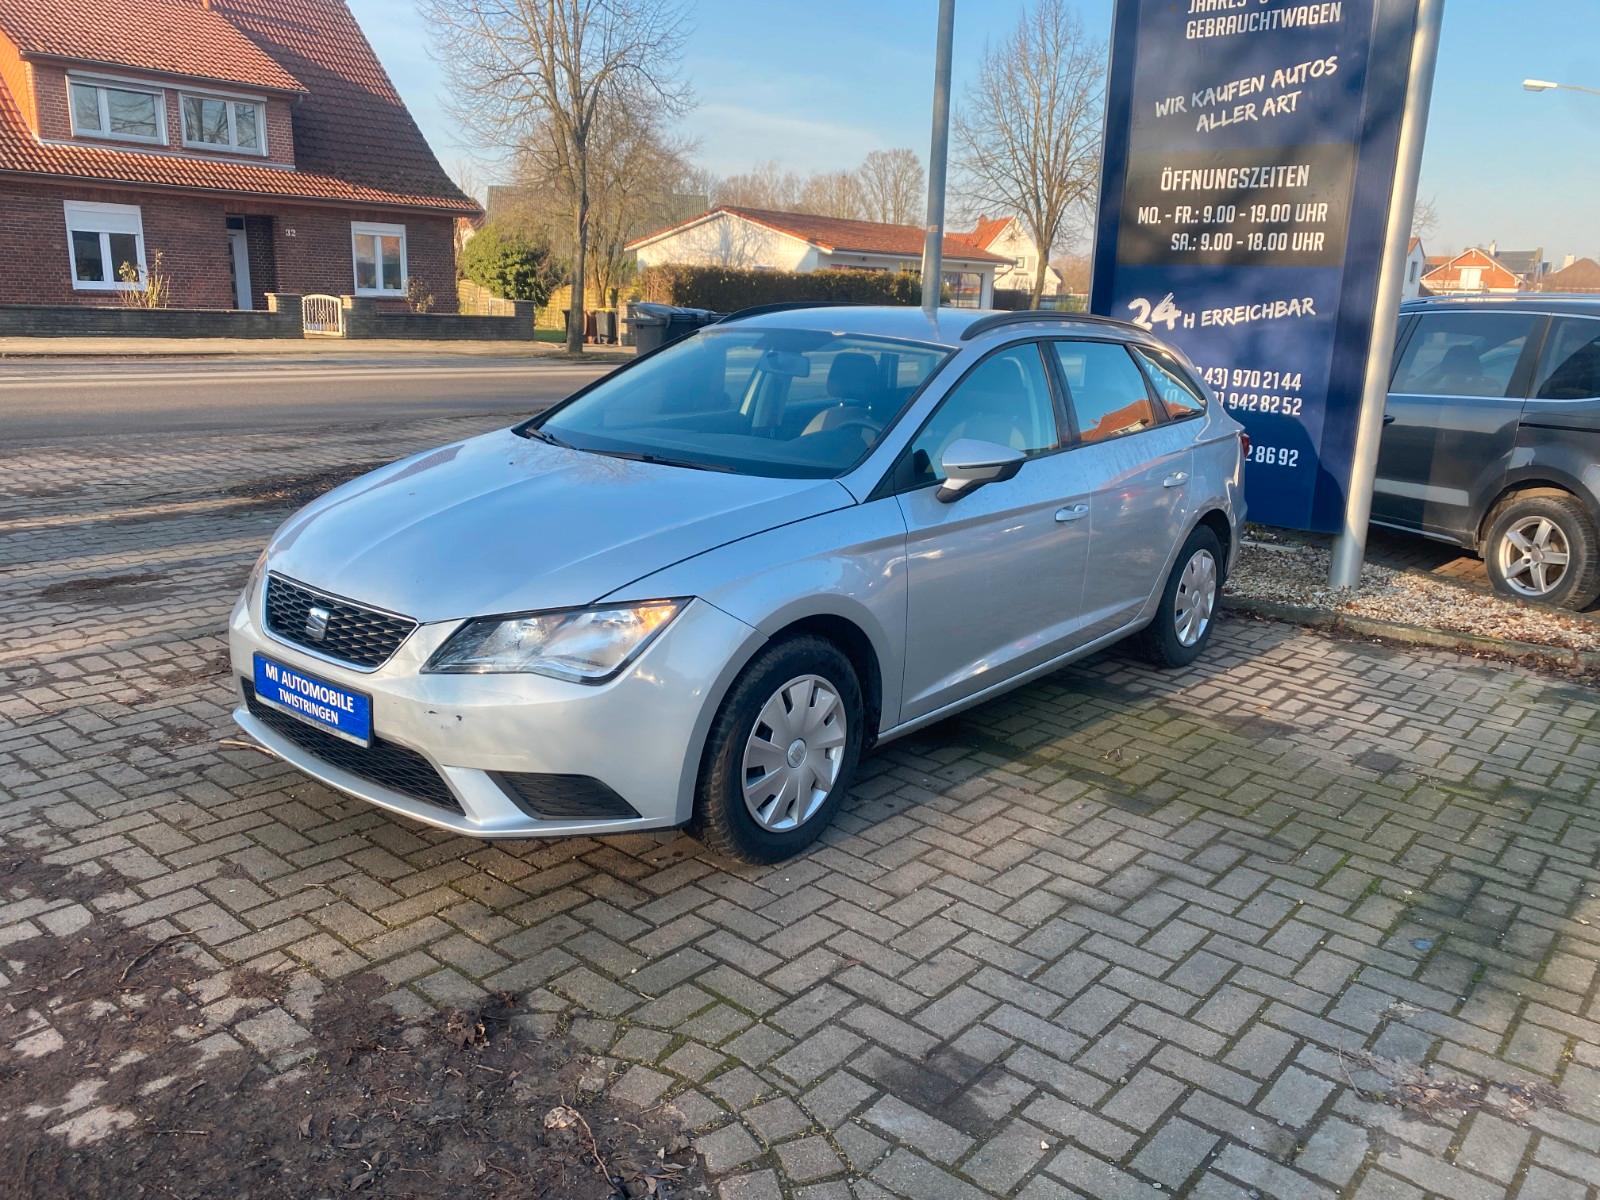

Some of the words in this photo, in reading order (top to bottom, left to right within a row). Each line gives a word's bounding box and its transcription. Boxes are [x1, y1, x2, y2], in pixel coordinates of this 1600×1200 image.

[1186, 2, 1342, 39] GEBRAUCHTWAGEN
[1155, 95, 1187, 117] WIR
[1191, 74, 1265, 108] KAUFEN
[1271, 55, 1338, 89] AUTOS
[1196, 103, 1258, 133] ALLER
[1262, 91, 1302, 117] ART
[1160, 165, 1310, 192] ÖFFNUNGSZEITEN
[1137, 206, 1162, 224] MO.
[1174, 206, 1199, 224] FR.:
[1203, 205, 1236, 223] 9.00
[1250, 204, 1291, 223] 19.00
[1295, 202, 1328, 222] UHR
[285, 228, 296, 237] 32
[1171, 233, 1197, 251] SA.:
[1200, 232, 1234, 251] 9.00
[1247, 232, 1288, 251] 18.00
[1291, 232, 1325, 251] UHR
[1201, 297, 1316, 327] ERREICHBAR
[265, 663, 279, 682] MI
[281, 670, 354, 713] AUTOMOBILE
[278, 687, 339, 725] TWISTRINGEN
